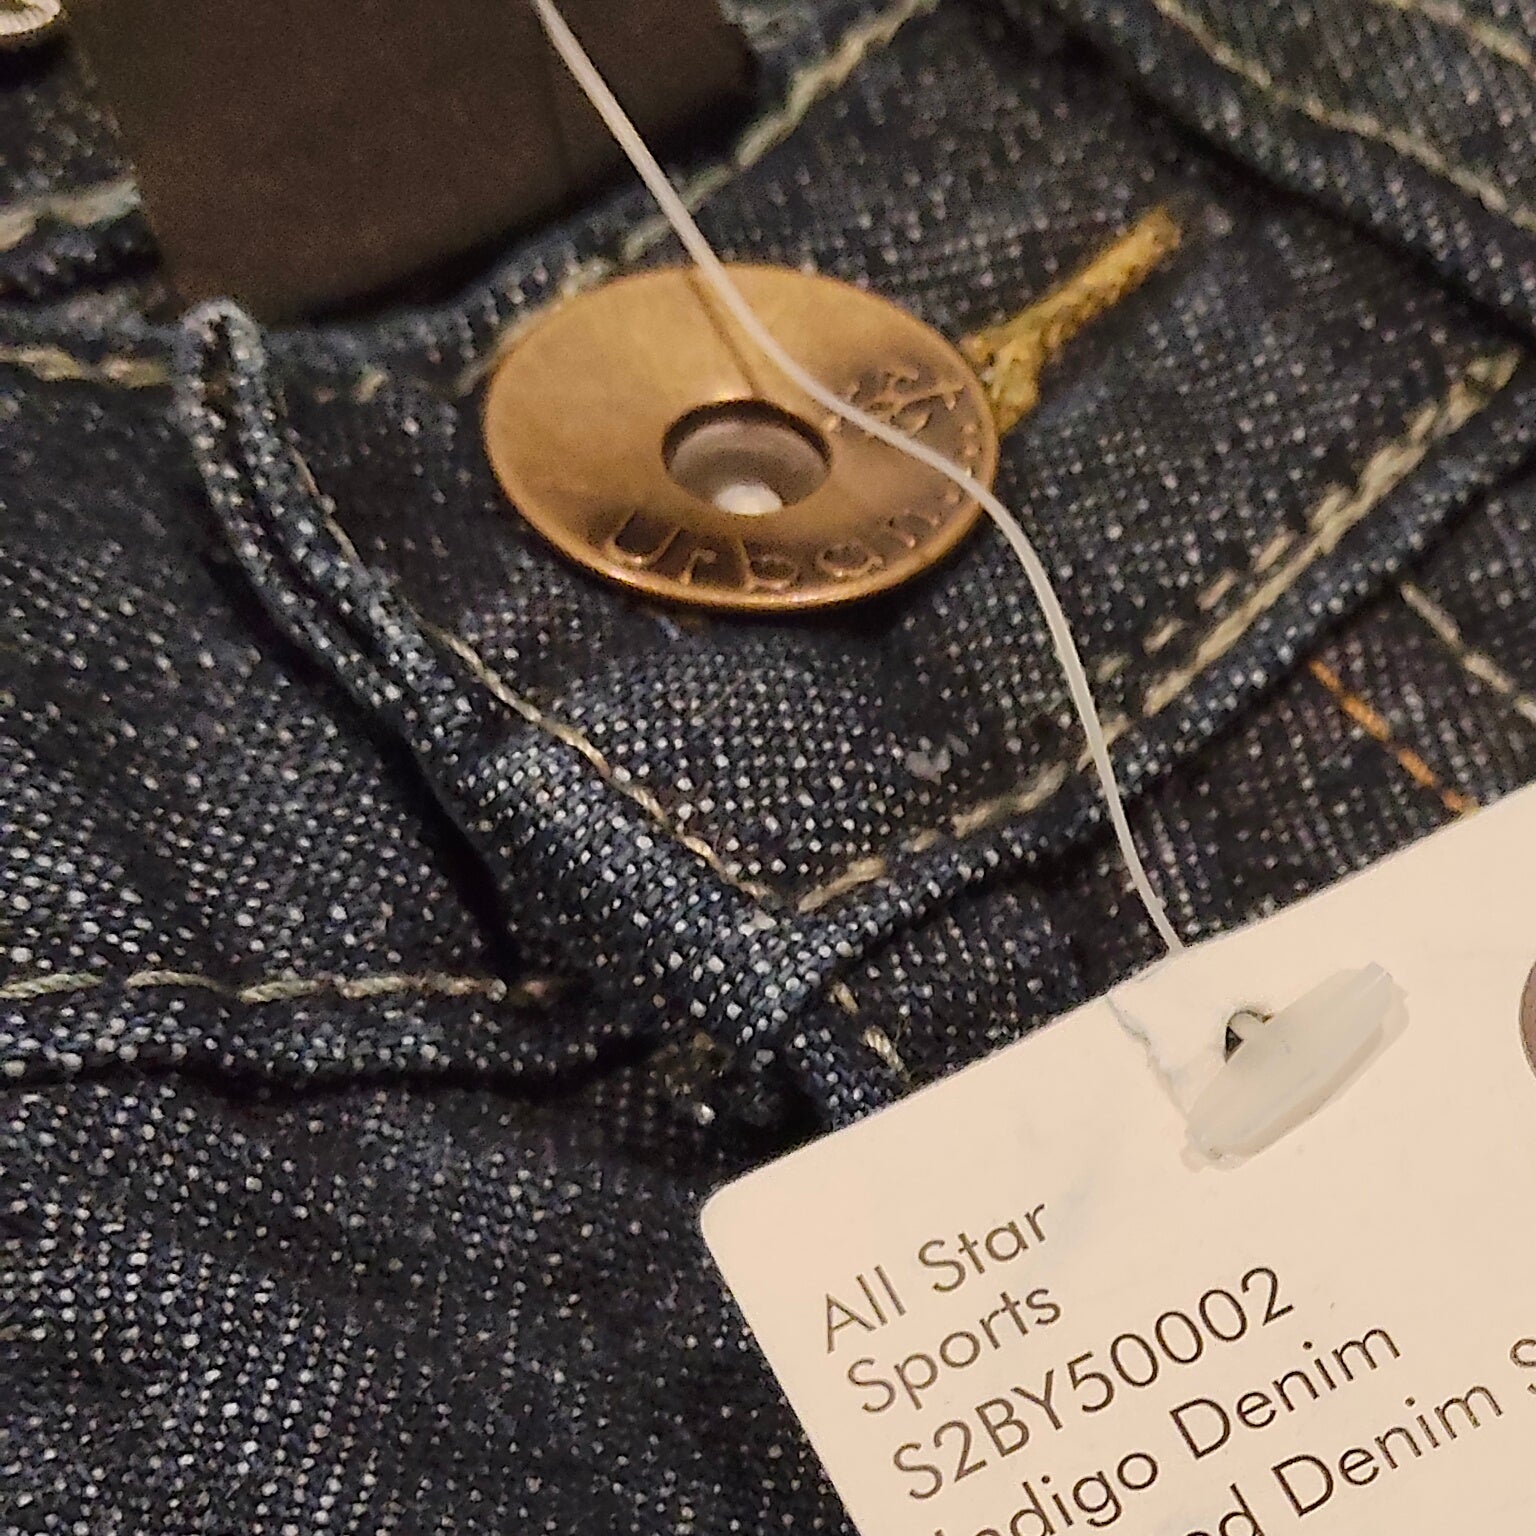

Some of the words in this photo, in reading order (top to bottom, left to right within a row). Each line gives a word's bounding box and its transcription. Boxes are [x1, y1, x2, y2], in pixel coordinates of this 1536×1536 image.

[824, 1264, 907, 1355] All
[917, 1202, 1048, 1294] Star
[846, 1286, 1062, 1414] Sports
[892, 1265, 1295, 1501] S2BY50002
[1168, 1328, 1402, 1461] Denim
[1270, 1385, 1504, 1519] Denim
